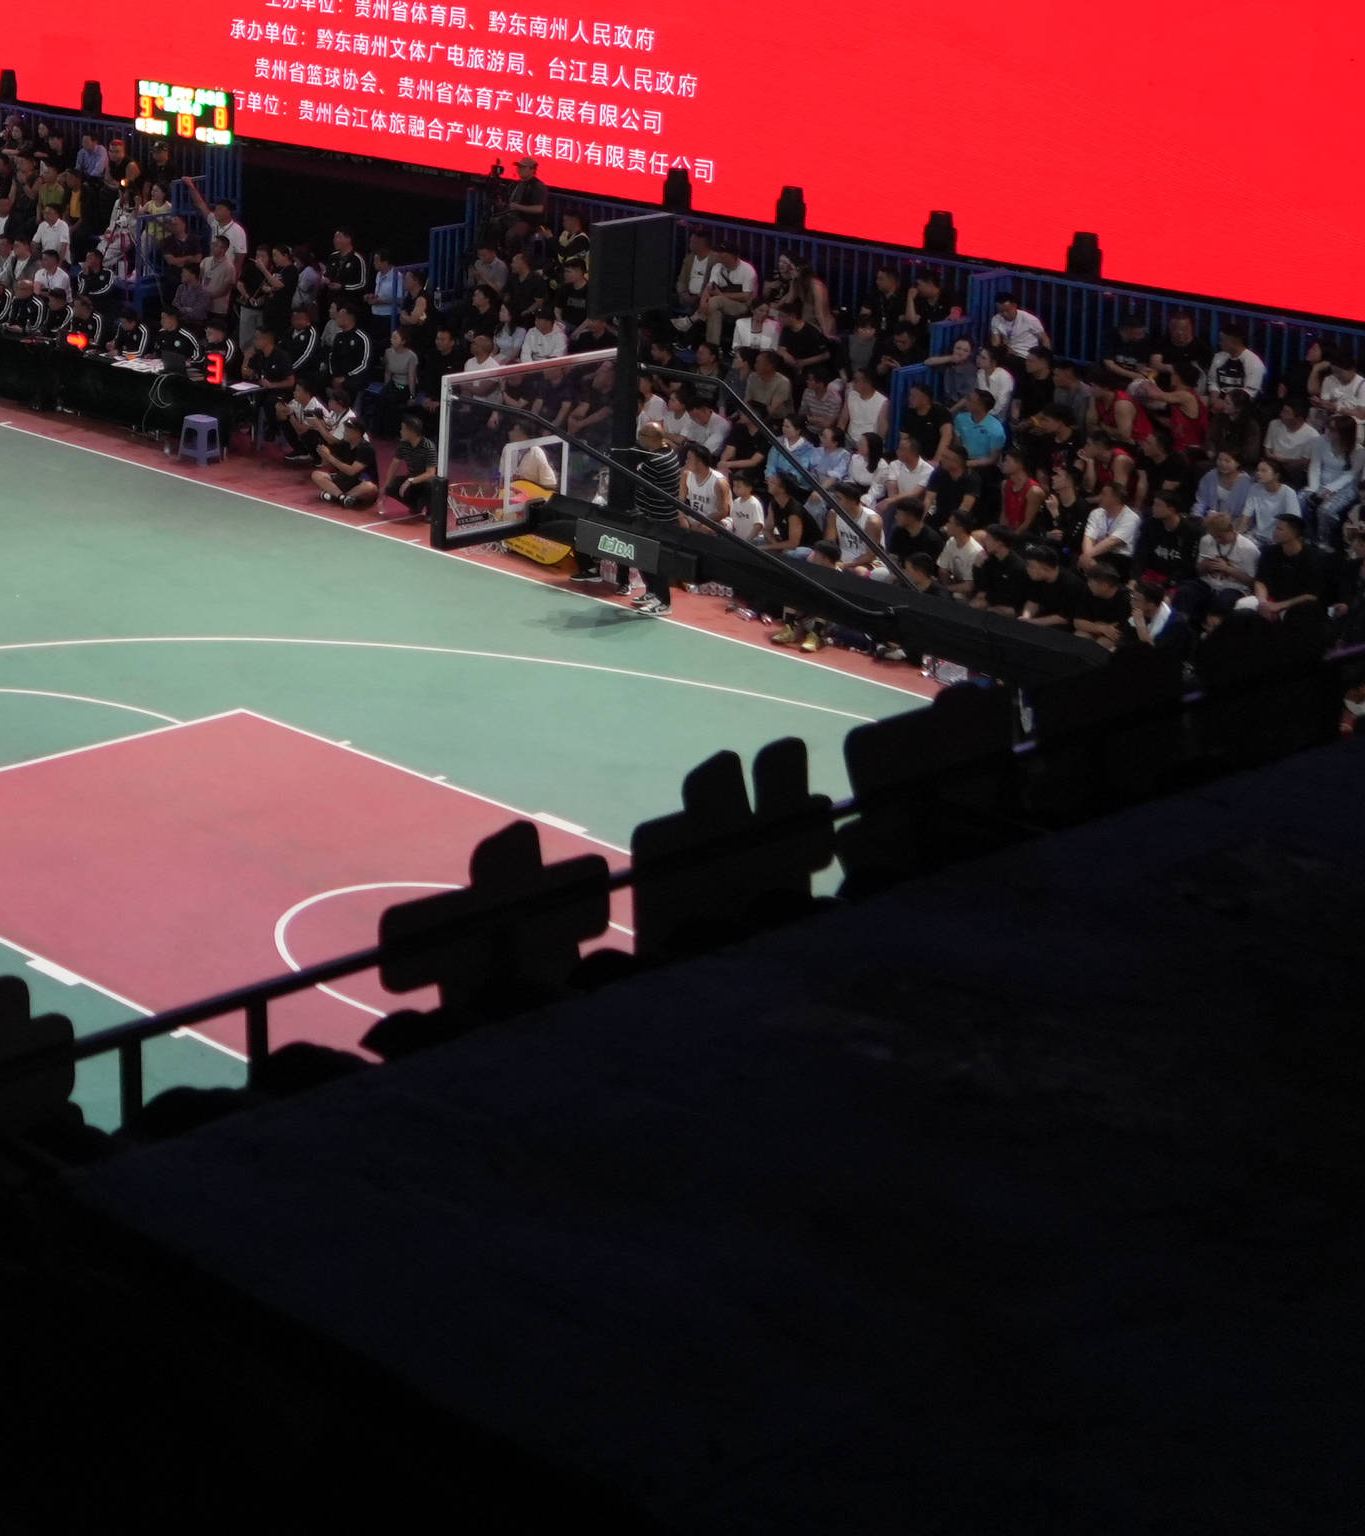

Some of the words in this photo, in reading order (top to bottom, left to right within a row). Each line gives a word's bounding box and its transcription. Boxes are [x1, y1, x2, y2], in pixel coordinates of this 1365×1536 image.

[140, 95, 153, 118] 9
[254, 57, 662, 135] 贵州省篮球协会、贵州省体育产业发展有限公司
[177, 114, 195, 138] 19
[214, 106, 228, 131] 8
[215, 86, 714, 183] 行单位：贵州台江体旅融合产业发展(集团)有限责任公司
